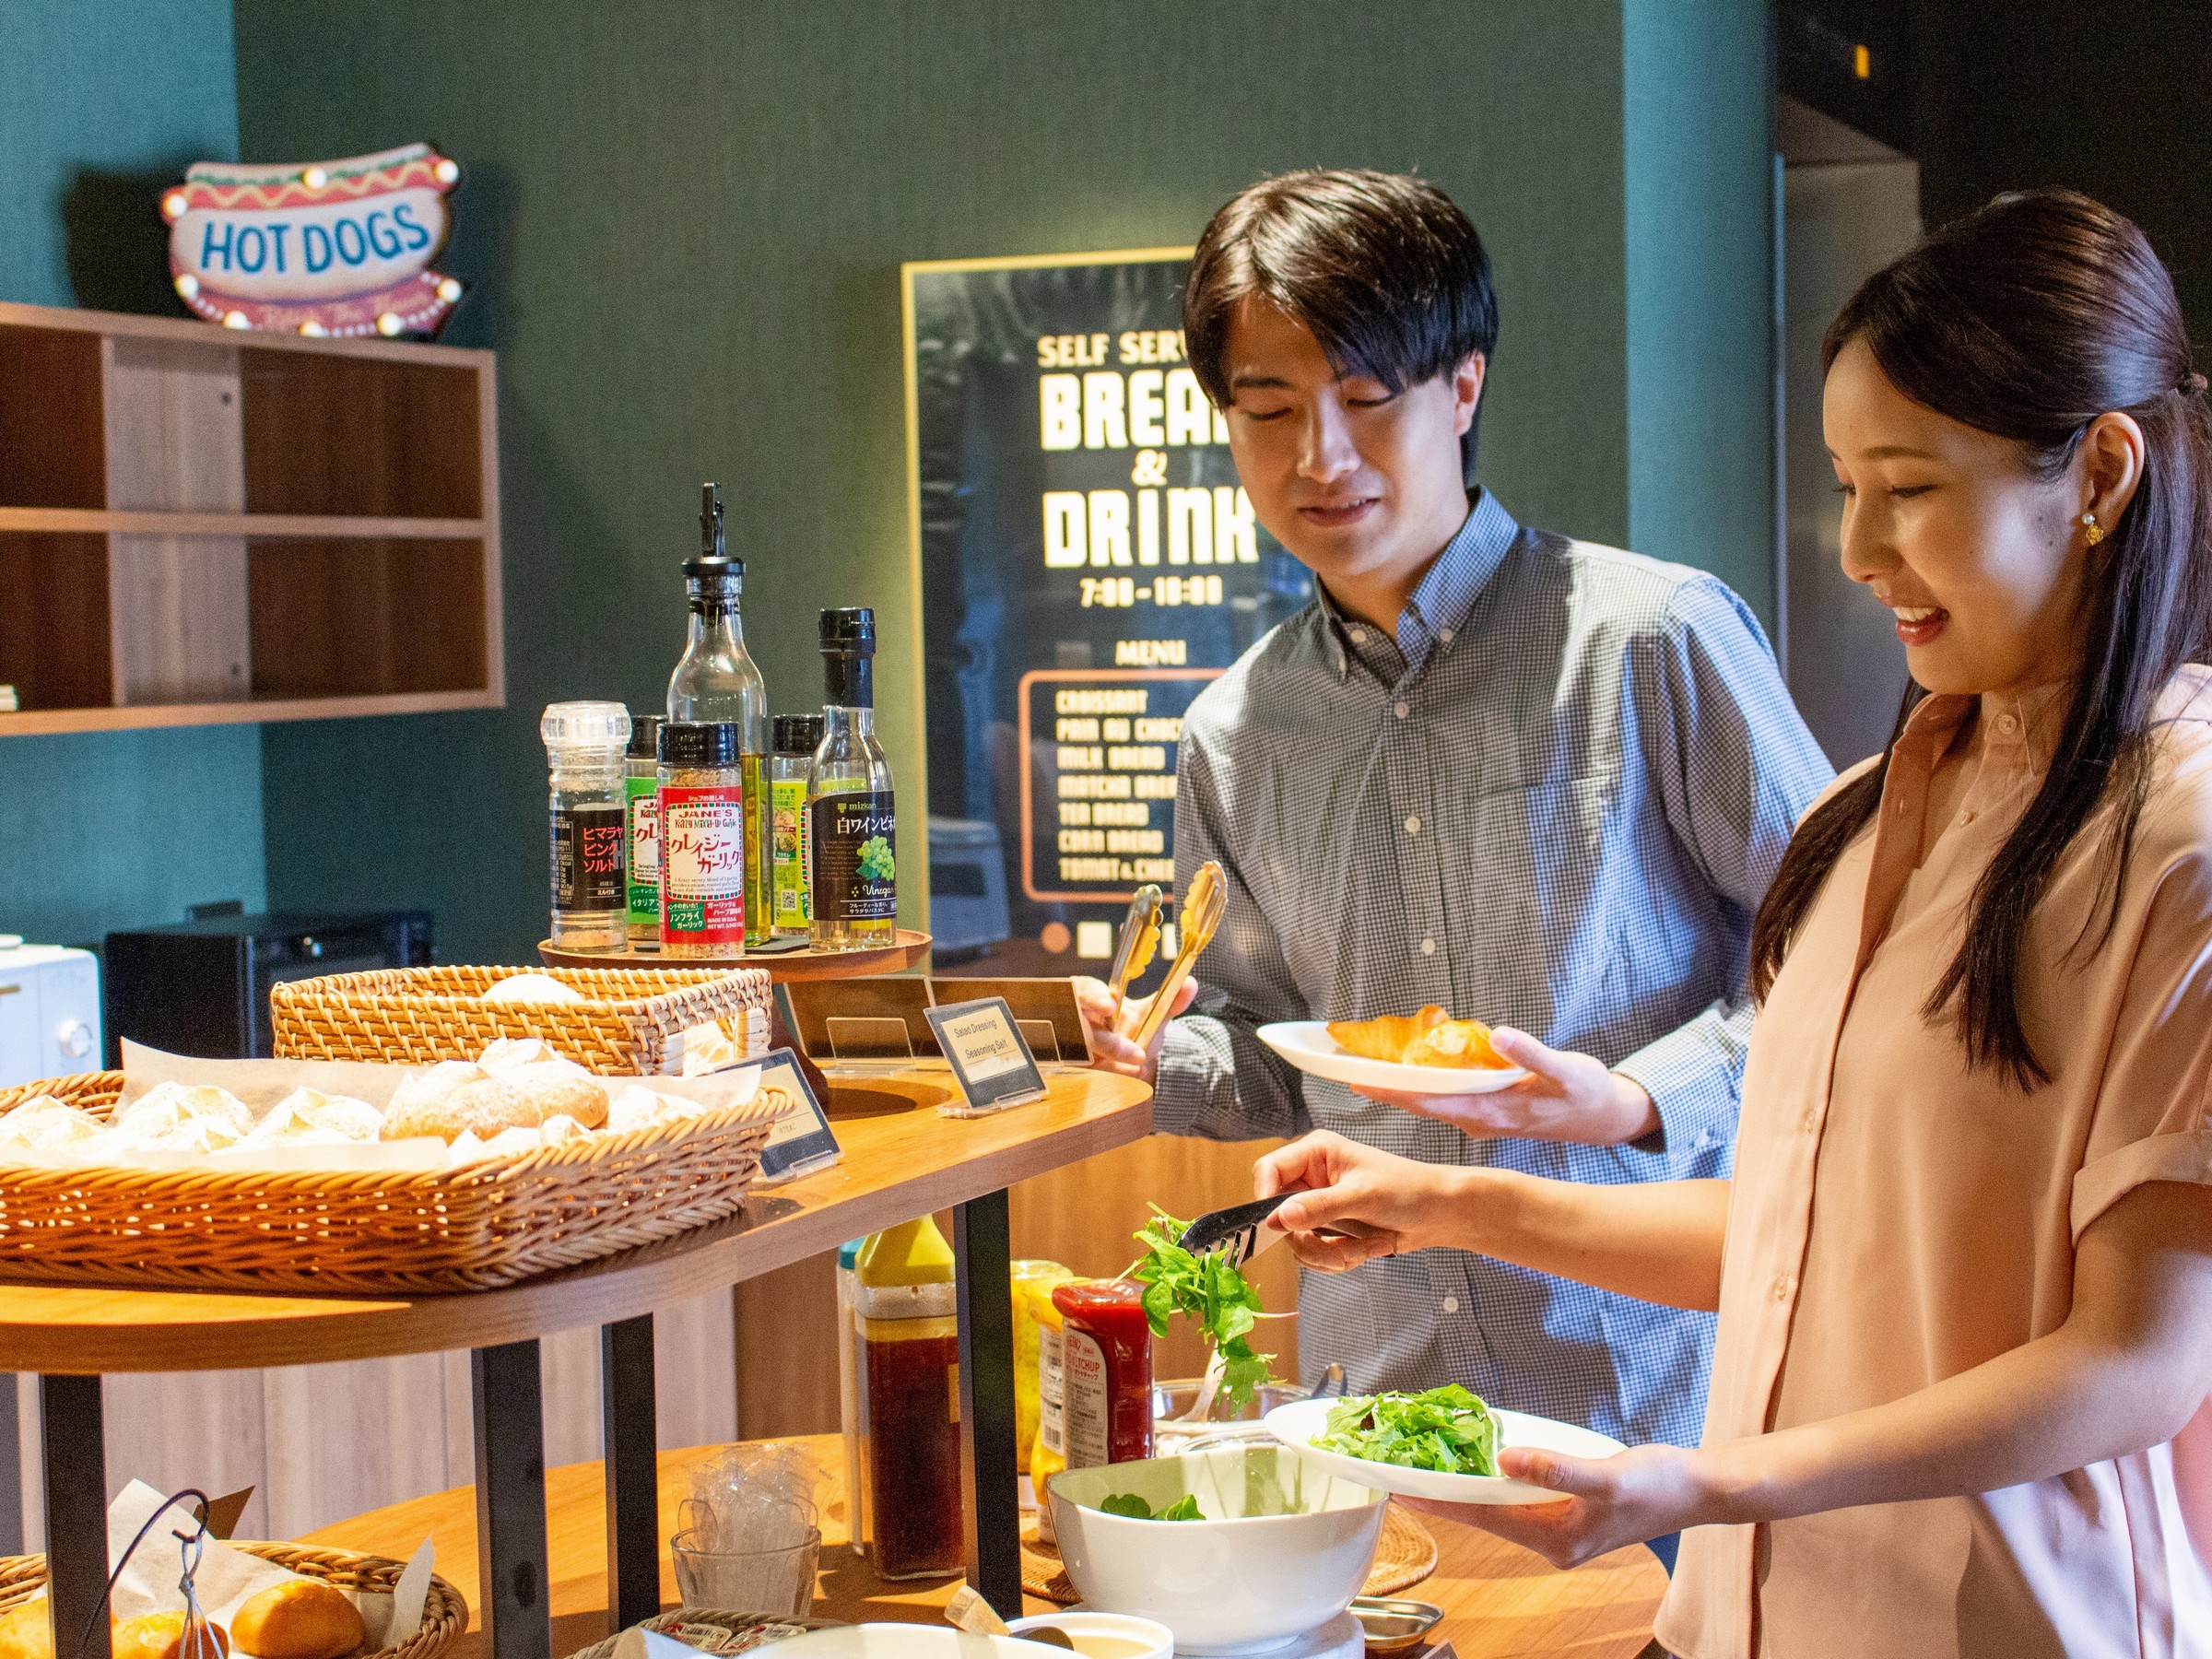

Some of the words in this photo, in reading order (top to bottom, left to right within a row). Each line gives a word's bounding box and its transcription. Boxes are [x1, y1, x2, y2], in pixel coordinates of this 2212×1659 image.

[200, 220, 292, 274] HOT
[301, 202, 430, 274] DOGS
[1037, 333, 1110, 368] SELF
[1131, 448, 1168, 487] &
[1115, 640, 1187, 665] MENU
[678, 809, 733, 818] JANE'S
[849, 802, 877, 810] mizkan
[583, 826, 624, 841] ヒマラヤ
[584, 841, 618, 856] ピンク
[671, 833, 731, 859] クレイジー
[583, 859, 617, 873] ソルト
[697, 850, 739, 875] ガーリック
[670, 911, 700, 922] ノンフライ
[954, 1025, 972, 1038] Salad
[971, 1019, 997, 1033] Dressing
[965, 1042, 997, 1059] Seasoning
